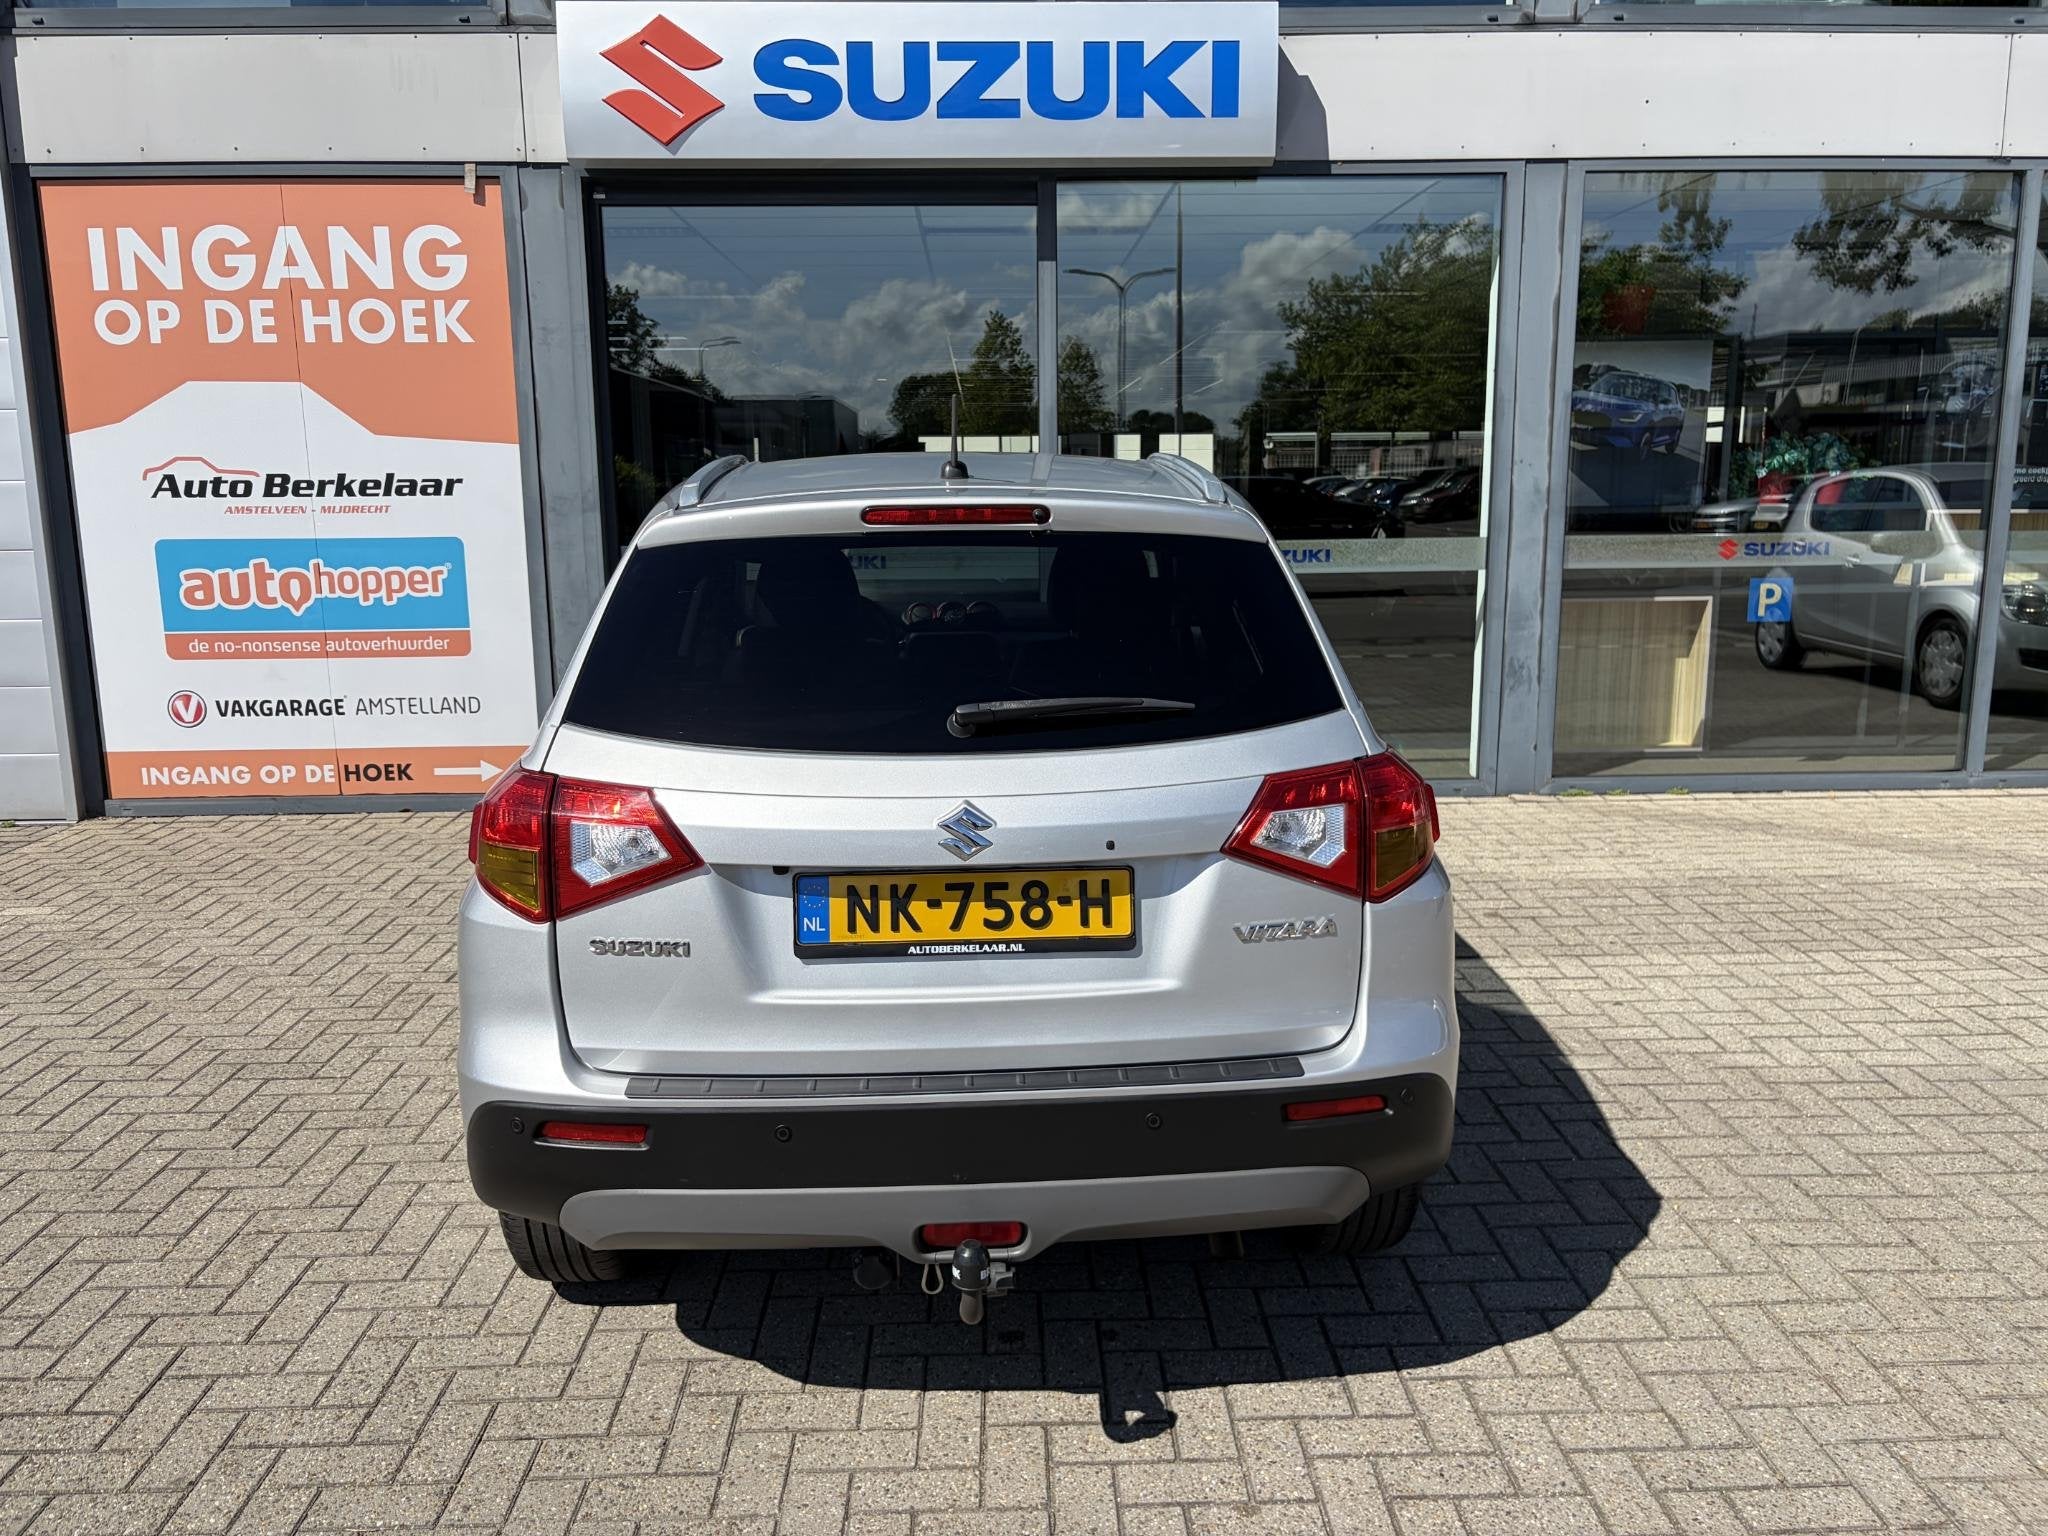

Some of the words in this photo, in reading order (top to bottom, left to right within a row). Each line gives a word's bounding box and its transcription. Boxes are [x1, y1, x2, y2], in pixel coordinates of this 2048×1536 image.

[753, 38, 1240, 121] SUZUKI
[87, 224, 468, 291] INGANG
[94, 299, 180, 345] OP
[204, 299, 278, 344] DE
[301, 298, 475, 344] HOEK
[151, 473, 254, 499] Auto
[262, 472, 463, 498] Berkelaar
[224, 504, 306, 515] AMSTELVEEN
[320, 504, 391, 514] MIJDRECHT
[1743, 542, 1830, 556] SUZUKI
[180, 558, 448, 615] autohopper
[1757, 583, 1783, 617] P
[188, 638, 210, 653] de
[214, 639, 321, 652] no-nonsense
[325, 636, 450, 652] autoverhuurder
[215, 697, 346, 717] VAKGARAGE
[355, 696, 481, 716] AMSTELLAND
[141, 765, 251, 785] INGANG
[259, 766, 297, 784] OP
[305, 764, 336, 783] DE
[344, 763, 414, 783] HOEK
[846, 879, 1114, 935] NK-758-H
[803, 916, 826, 932] NL
[1232, 914, 1338, 944] VITARA
[589, 939, 690, 957] SUZUKI
[907, 943, 1026, 955] AUTOBERKELAAR.NL
